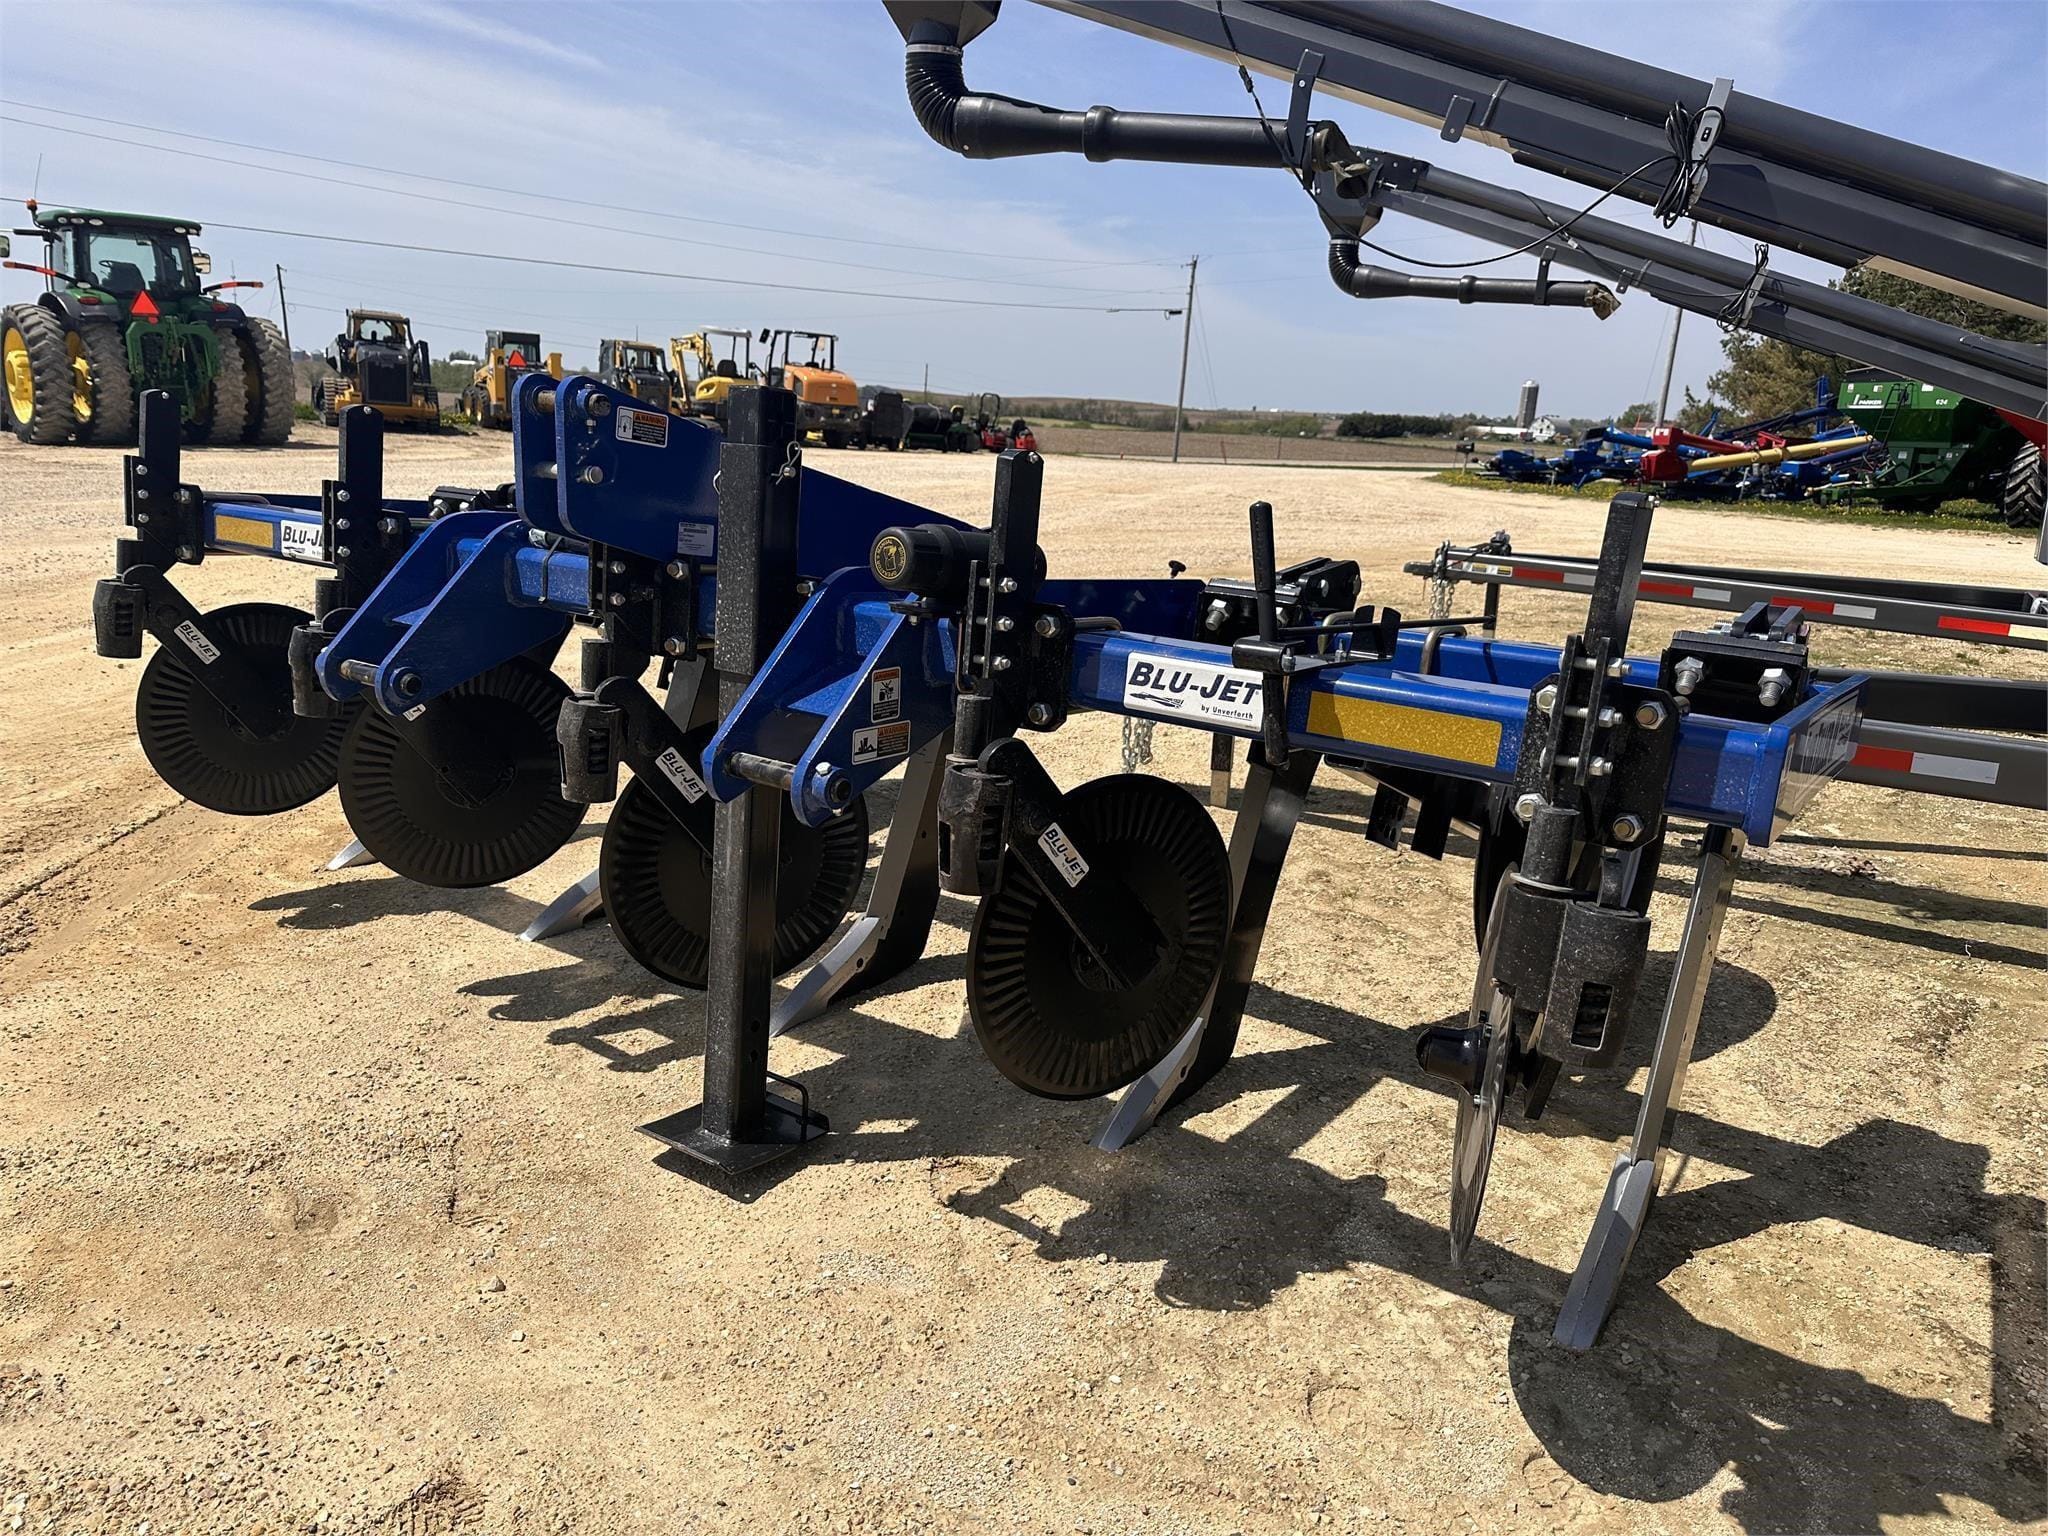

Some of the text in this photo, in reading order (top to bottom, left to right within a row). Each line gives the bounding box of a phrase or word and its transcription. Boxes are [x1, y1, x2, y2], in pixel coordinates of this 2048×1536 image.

[282, 525, 323, 547] BLU-J
[180, 624, 218, 658] BLU-JET
[1128, 661, 1262, 705] BLU-JET
[1201, 704, 1253, 719] by Unverforth
[662, 752, 704, 794] BLU-JET
[1045, 828, 1086, 876] BLU-JET
